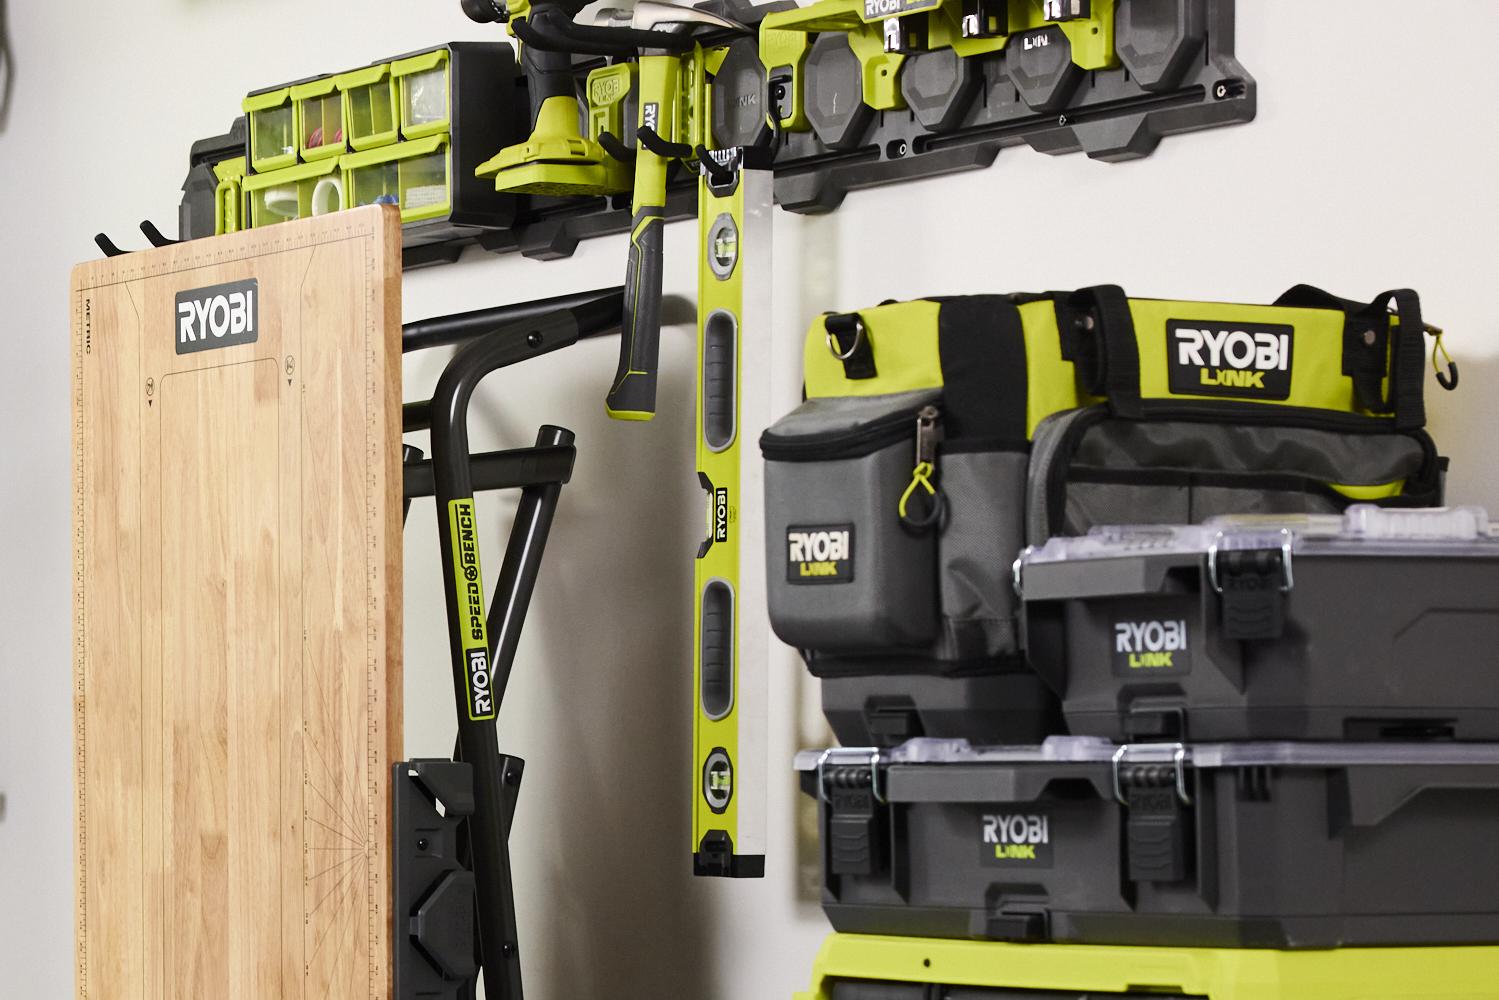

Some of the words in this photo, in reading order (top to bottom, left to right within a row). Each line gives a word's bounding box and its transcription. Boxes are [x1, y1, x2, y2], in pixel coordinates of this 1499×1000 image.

[865, 0, 900, 16] RYOBI
[1023, 33, 1052, 51] LIN
[178, 290, 252, 343] RYOBI
[1175, 328, 1290, 372] RYOBI
[460, 503, 476, 565] BENCH
[716, 490, 726, 539] RYOBI
[788, 531, 849, 562] RYOBI
[468, 583, 483, 641] SPEED
[1115, 620, 1187, 653] RYOBI
[471, 652, 491, 714] RYOBI
[982, 814, 1049, 844] RYOBI
